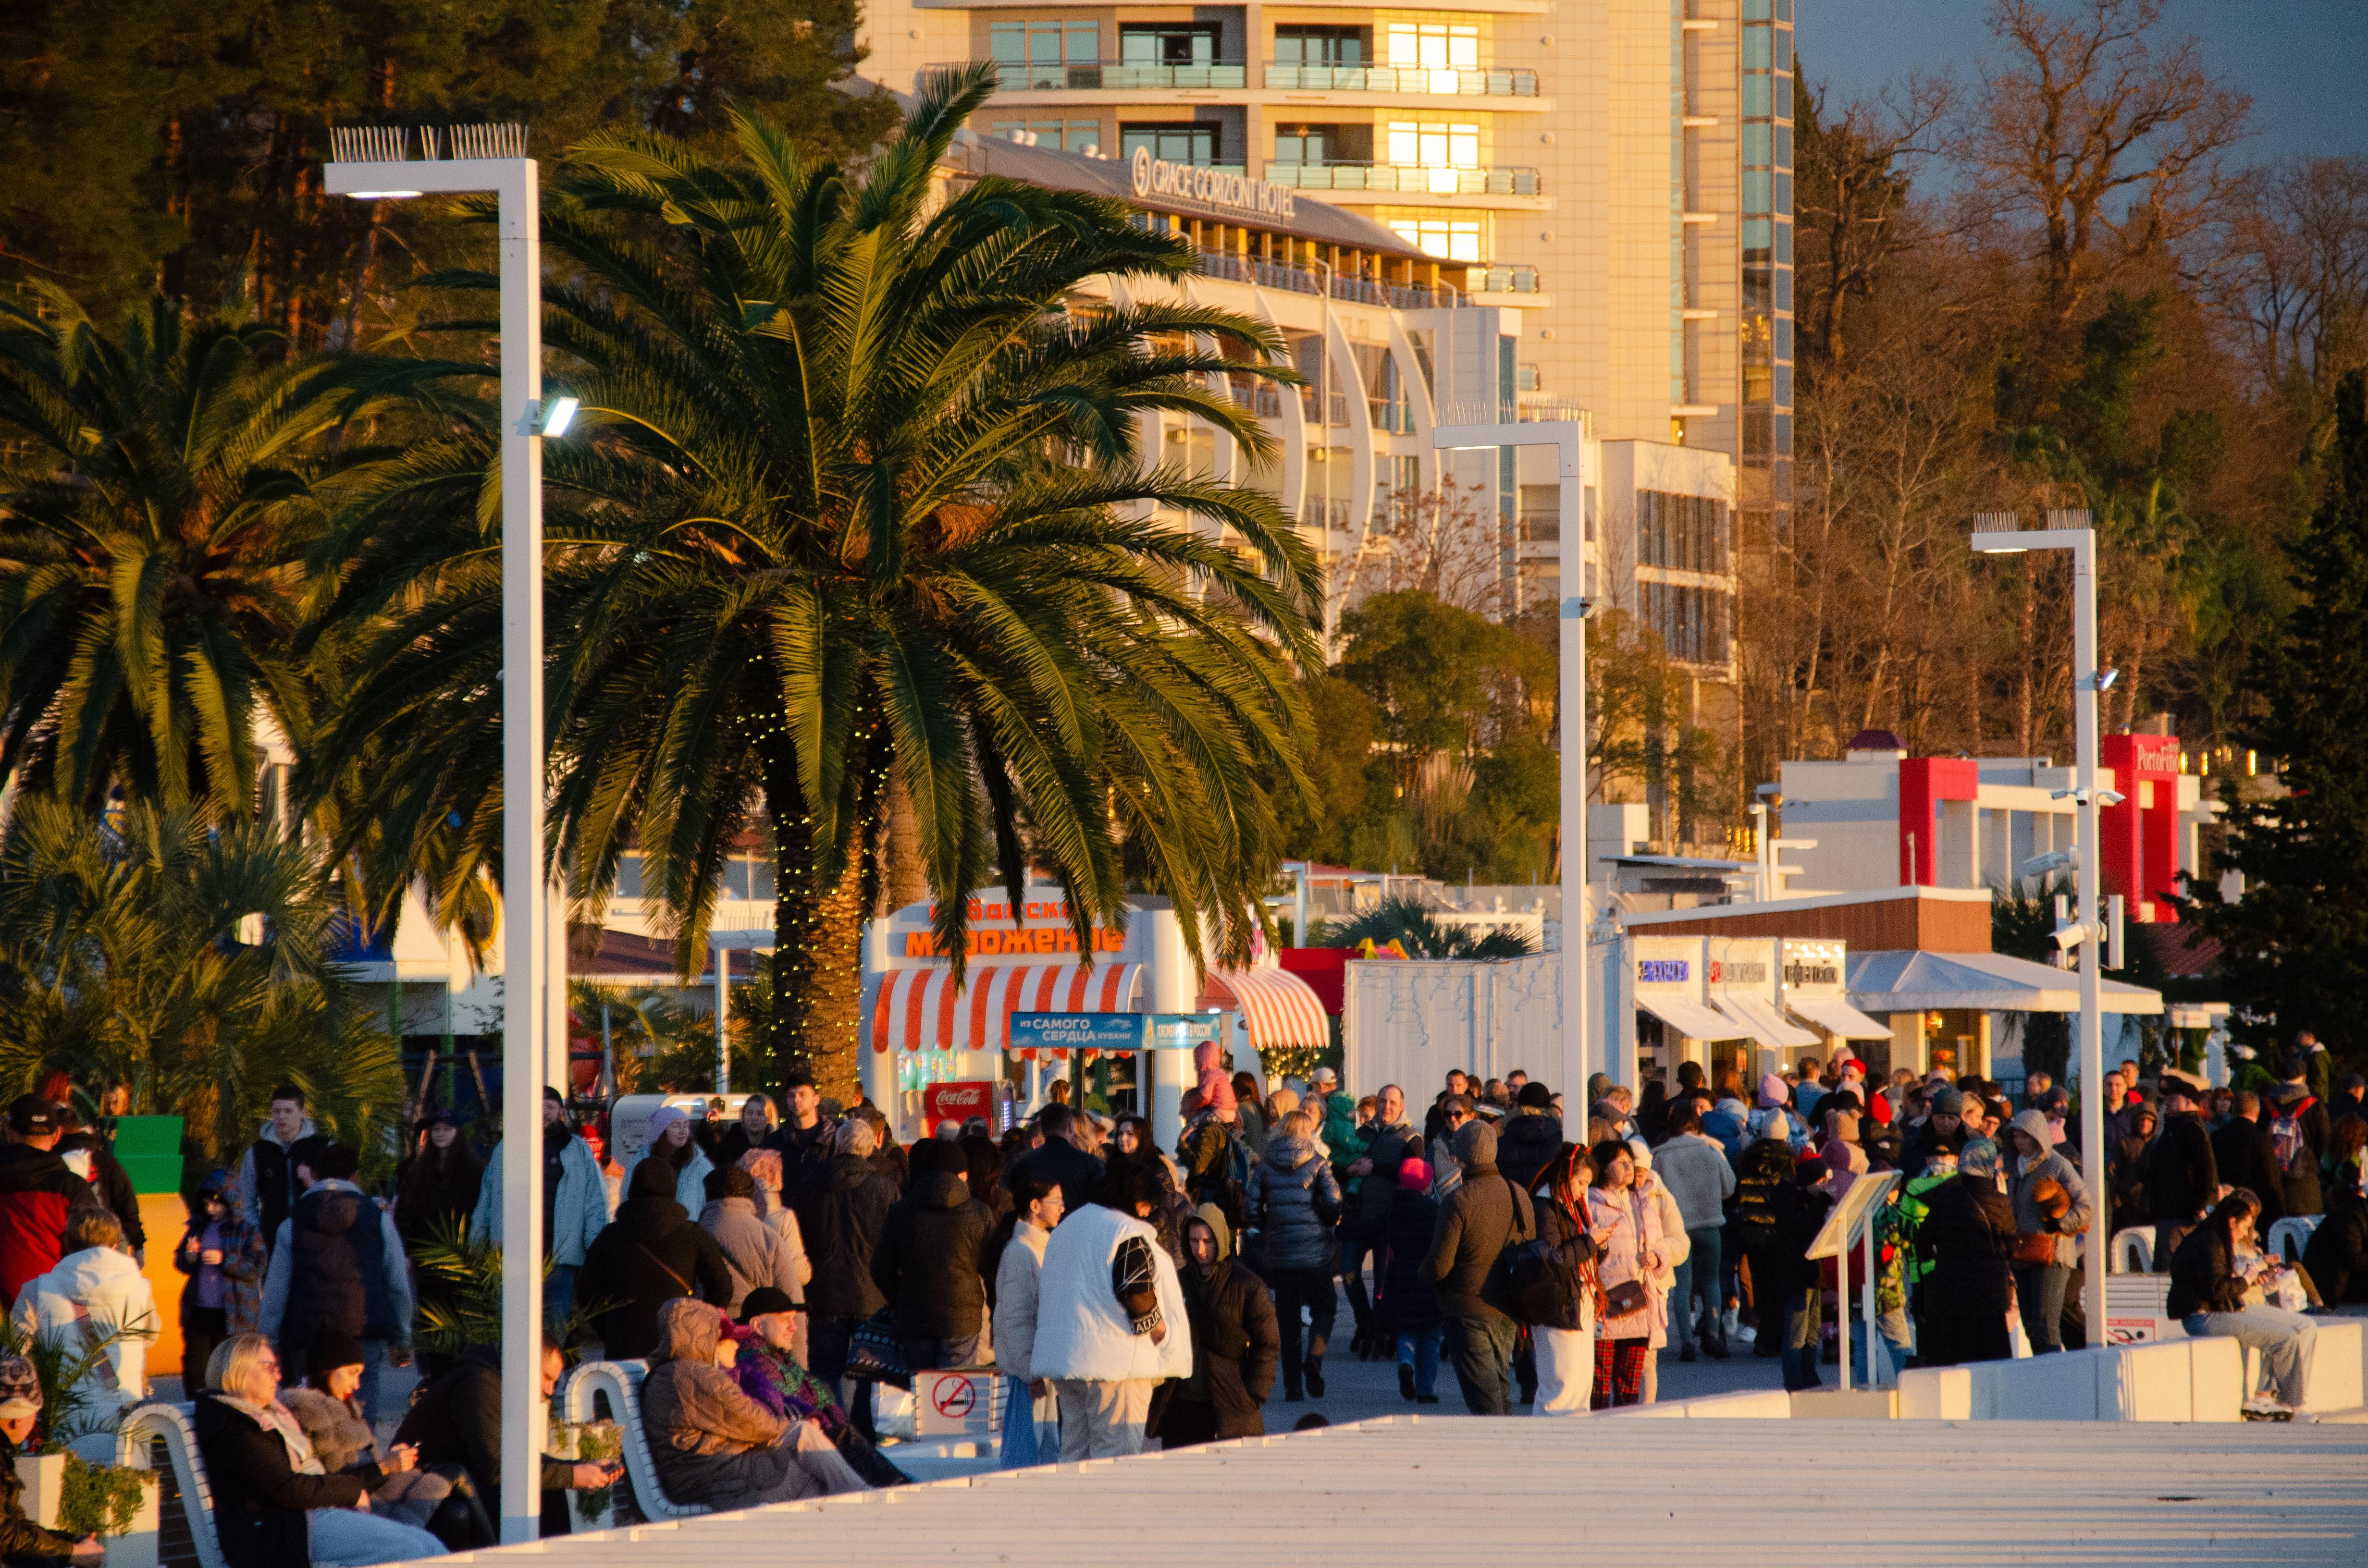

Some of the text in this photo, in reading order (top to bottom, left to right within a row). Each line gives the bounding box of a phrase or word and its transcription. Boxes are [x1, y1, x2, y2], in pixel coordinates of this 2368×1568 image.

[1154, 159, 1295, 217] GRACE GORIZONT HOTEL
[1033, 1018, 1090, 1029] САМОГО
[1042, 1030, 1096, 1043] СЕРДЦА
[1194, 1024, 1211, 1037] РОССИИ
[936, 1089, 981, 1105] Coca-Cola
